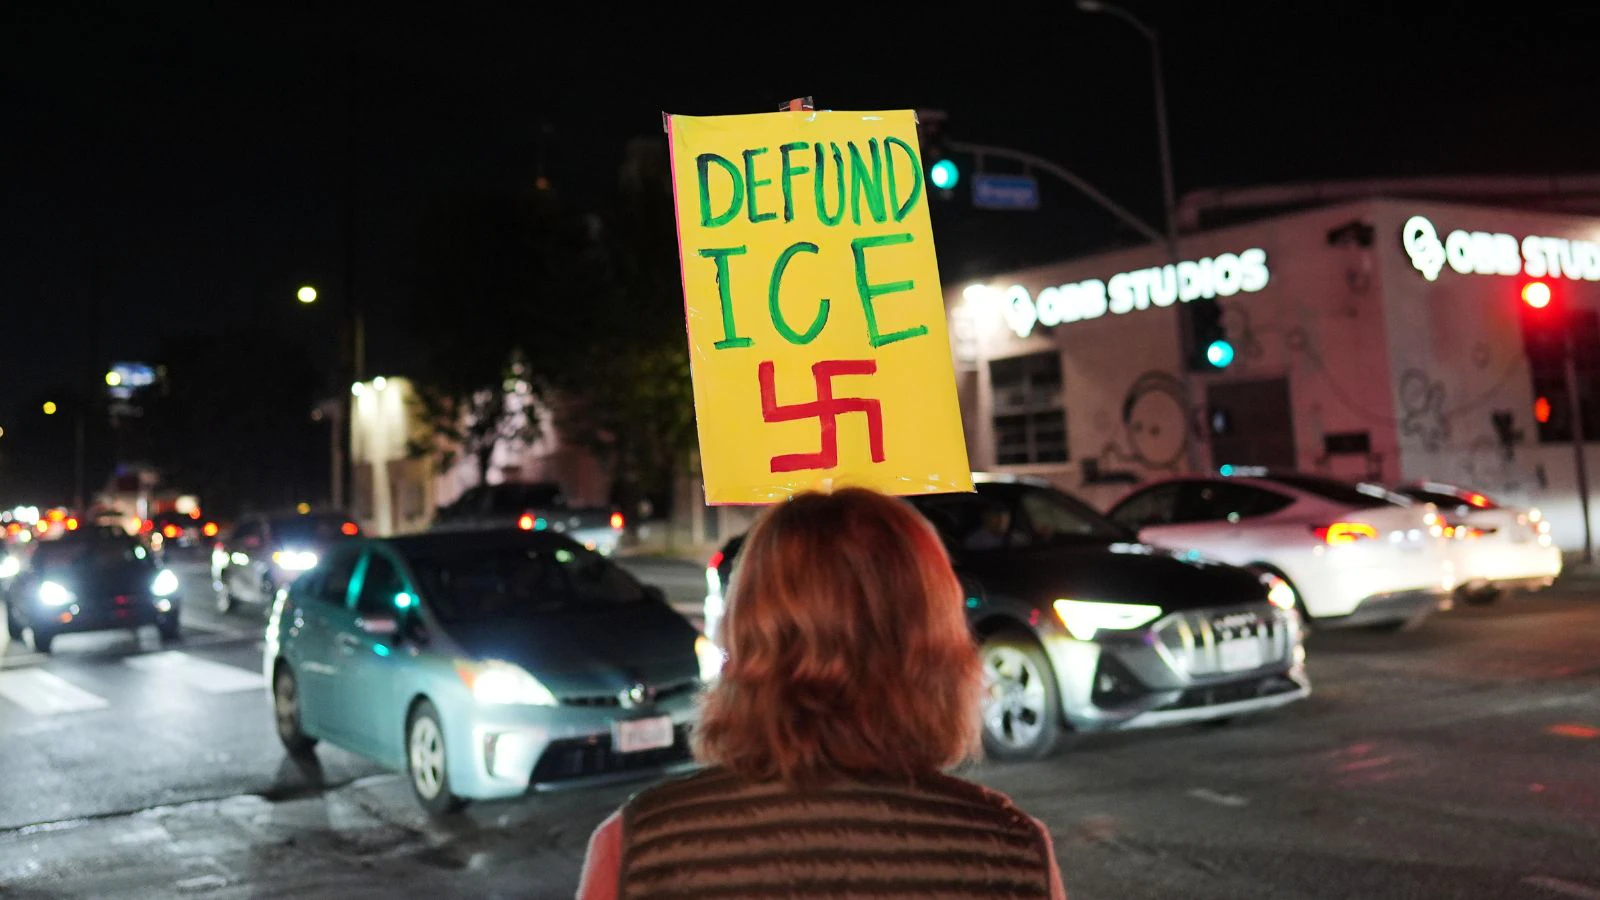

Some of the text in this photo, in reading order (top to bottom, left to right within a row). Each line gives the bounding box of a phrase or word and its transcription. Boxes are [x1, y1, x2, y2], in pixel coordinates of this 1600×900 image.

[695, 136, 922, 227] DEFUND
[698, 233, 928, 350] ICE
[1107, 248, 1269, 314] STUDIOS
